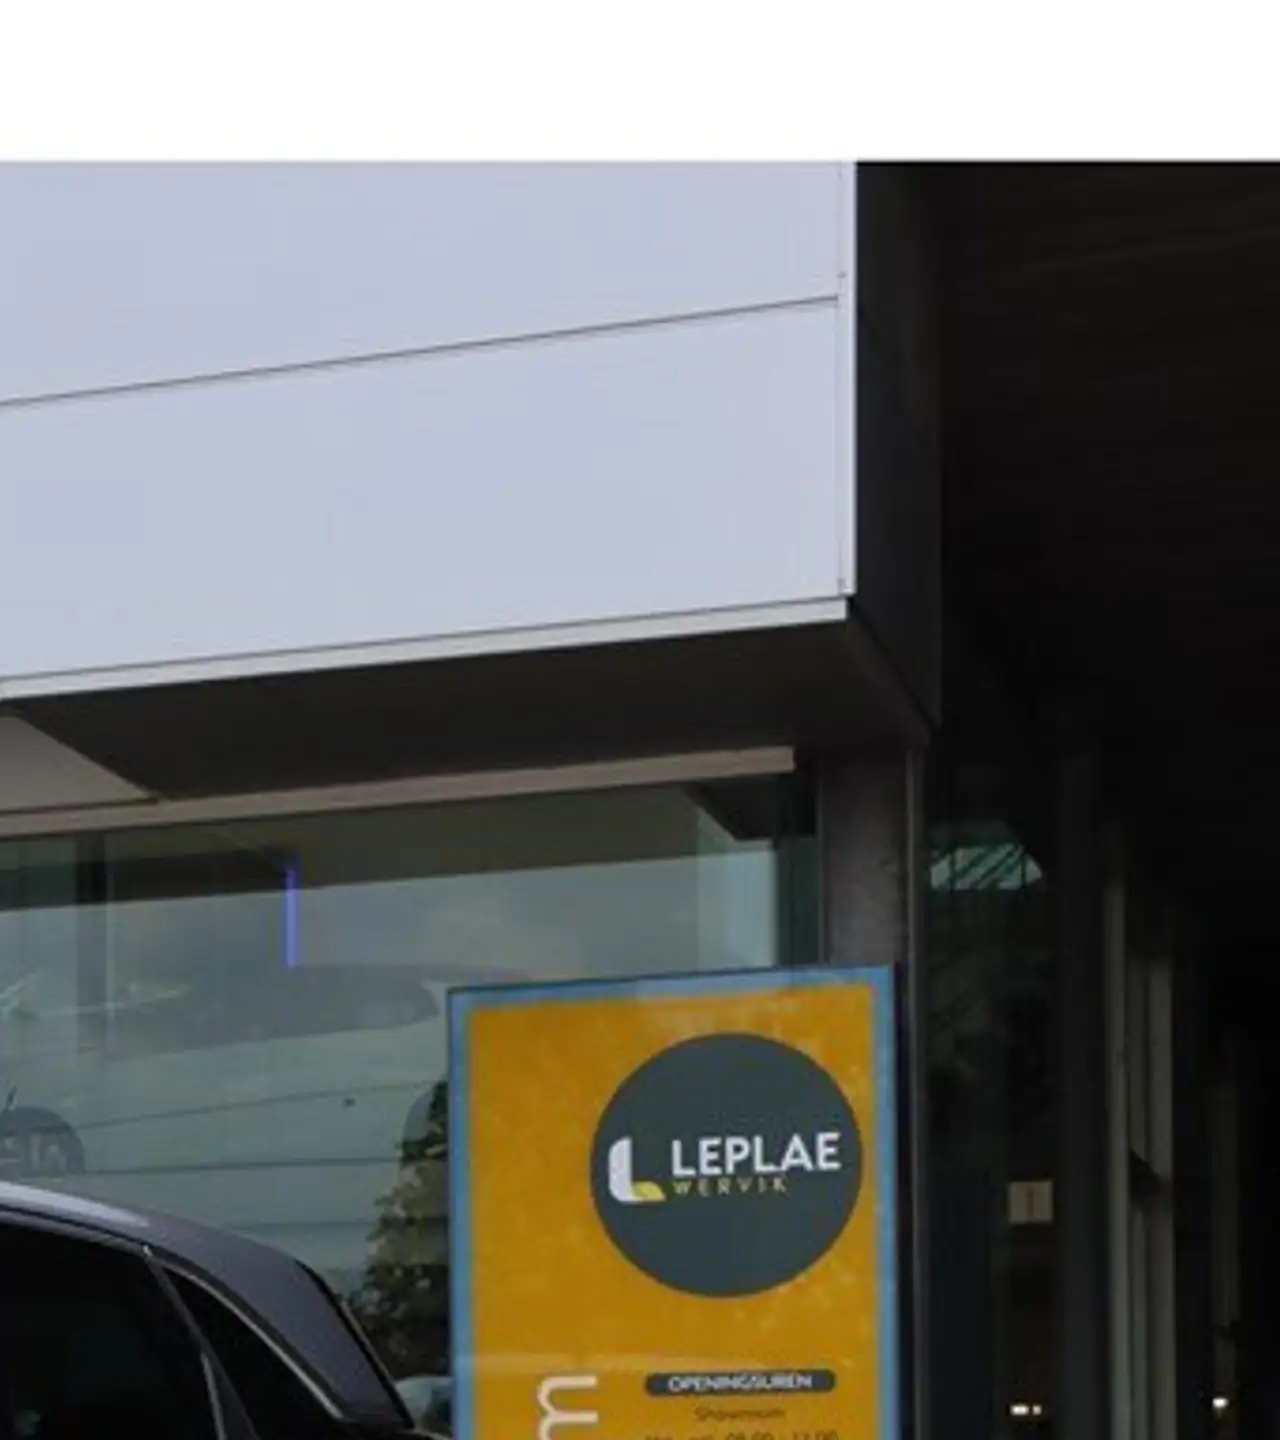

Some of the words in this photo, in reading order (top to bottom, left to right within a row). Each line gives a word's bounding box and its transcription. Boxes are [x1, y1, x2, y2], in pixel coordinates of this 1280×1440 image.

[671, 1131, 842, 1177] LEPLAE
[672, 1175, 789, 1197] WERVIK
[667, 1372, 813, 1393] OPENINGSUREN
